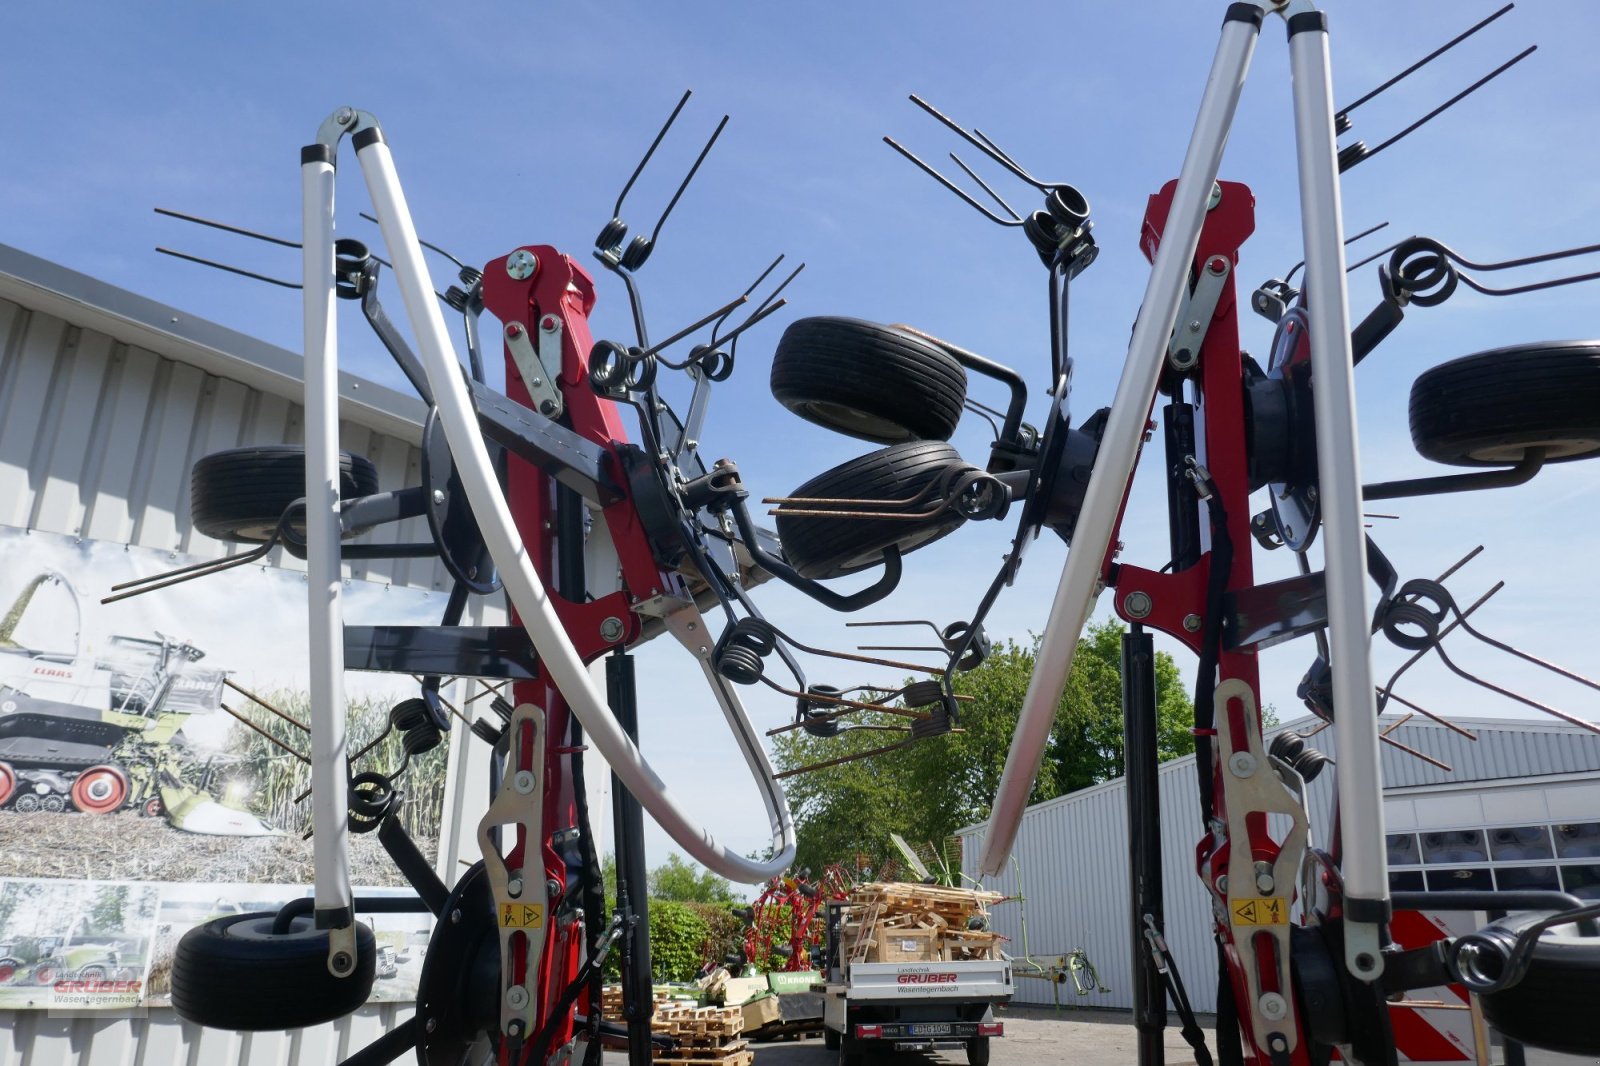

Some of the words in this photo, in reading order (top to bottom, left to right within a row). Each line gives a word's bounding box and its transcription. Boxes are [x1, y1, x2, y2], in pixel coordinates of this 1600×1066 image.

[33, 667, 73, 679] CLAAS
[787, 976, 816, 984] KRONE
[897, 974, 958, 984] GRUBER
[897, 985, 959, 993] Wasentegernbach
